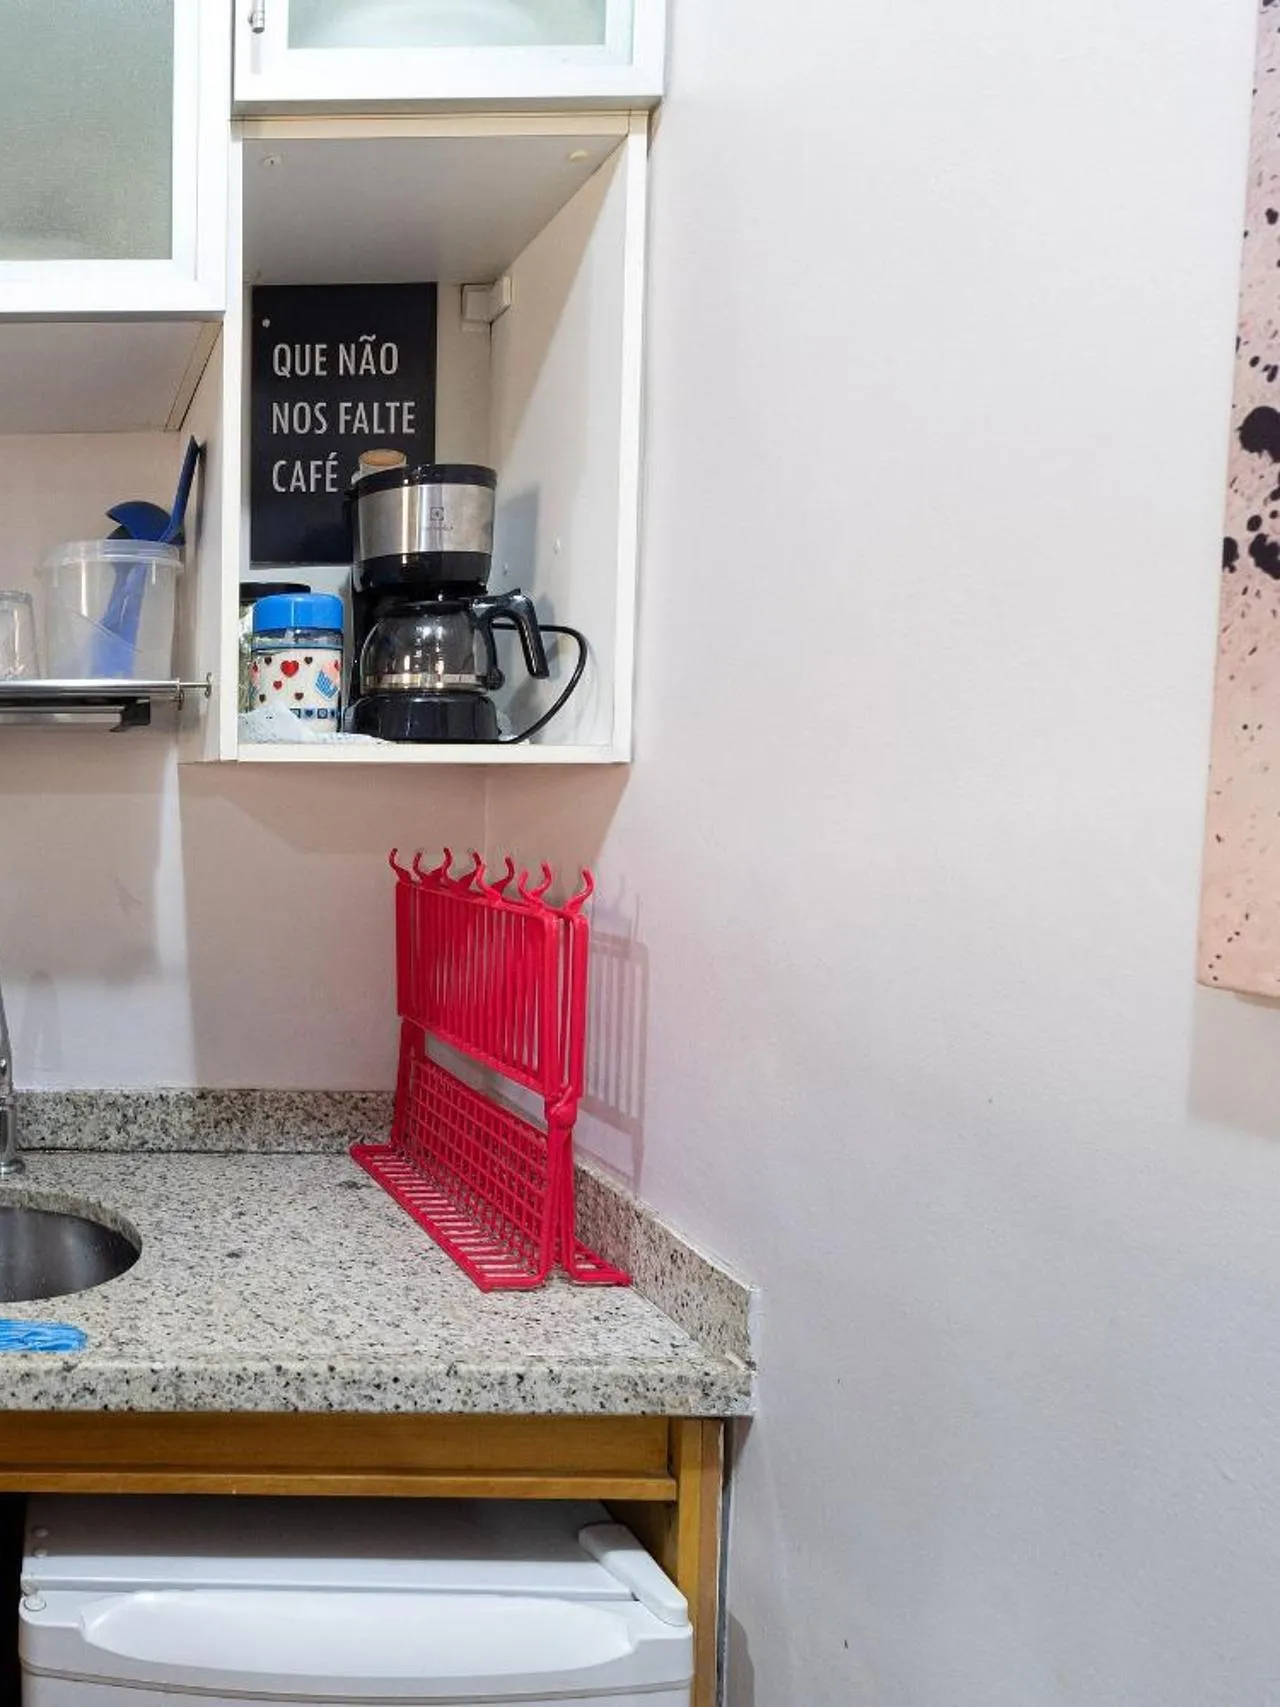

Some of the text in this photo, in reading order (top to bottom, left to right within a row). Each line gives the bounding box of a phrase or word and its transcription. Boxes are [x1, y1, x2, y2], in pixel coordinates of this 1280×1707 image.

[272, 334, 399, 378] QUE NÃO
[272, 402, 416, 434] NOS FALTE
[272, 452, 339, 493] CAFÉ
